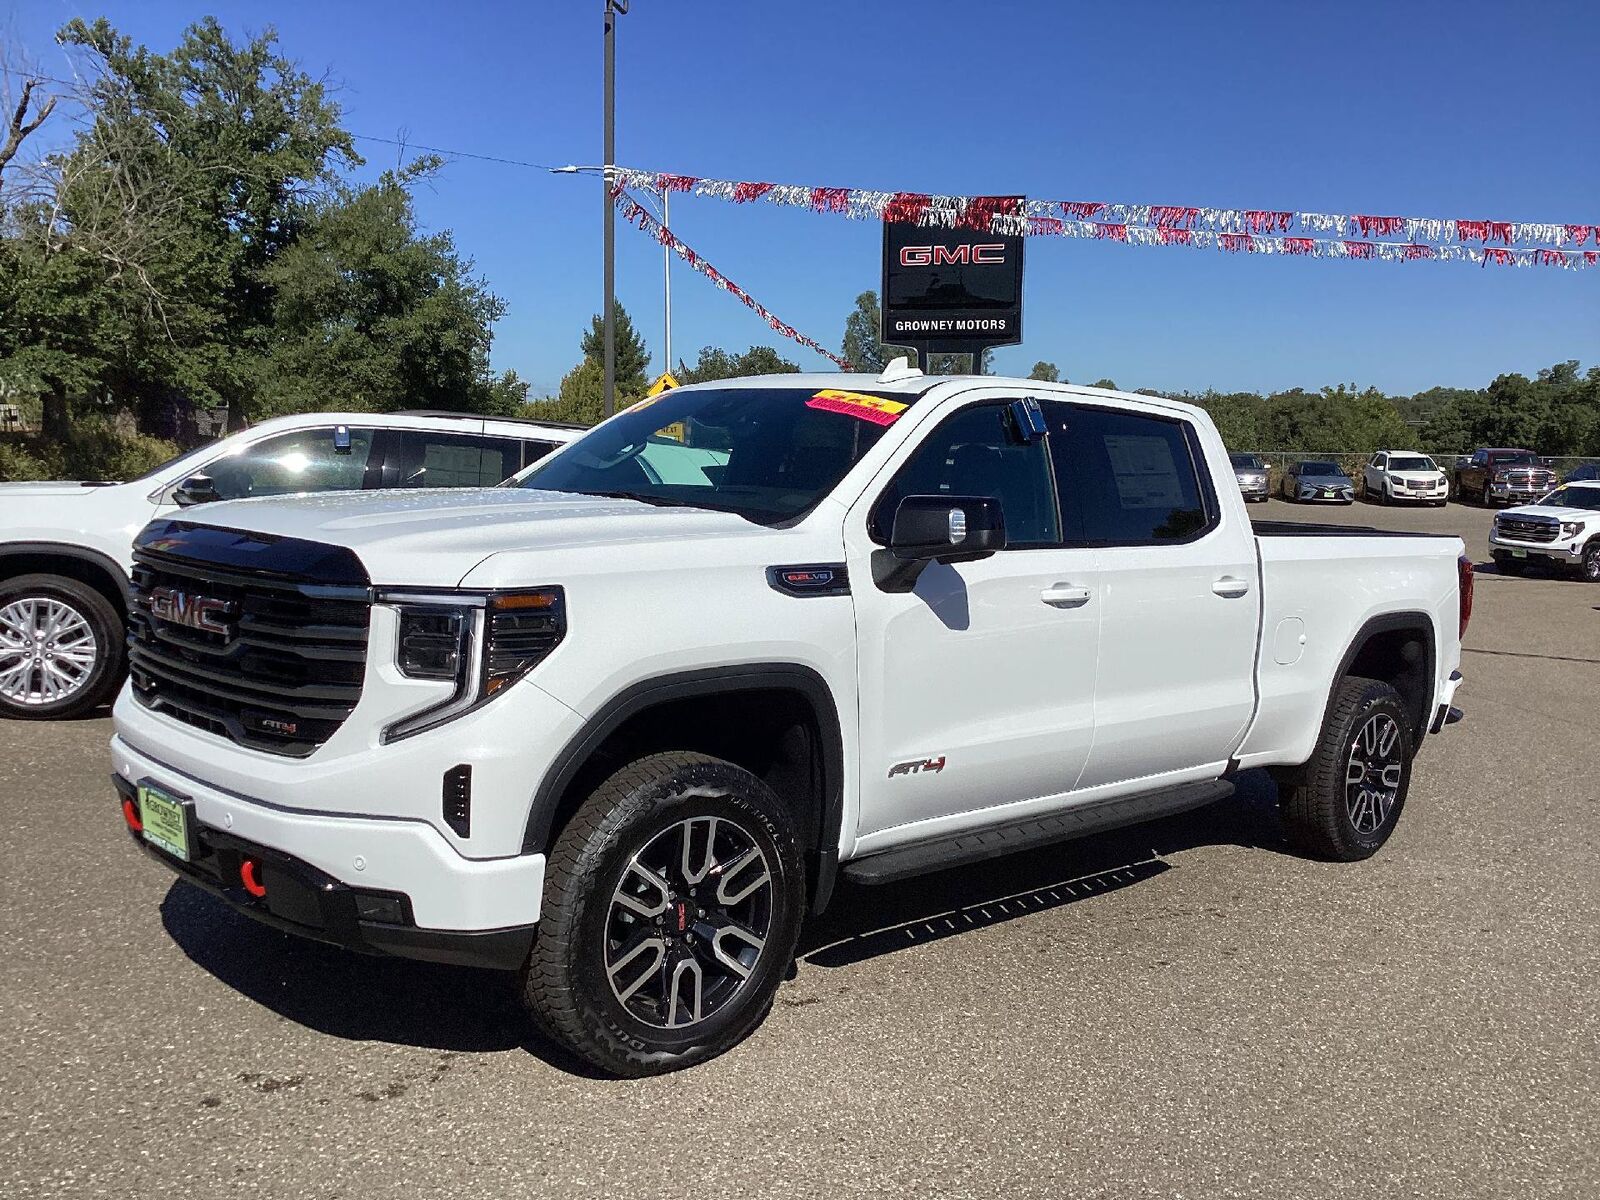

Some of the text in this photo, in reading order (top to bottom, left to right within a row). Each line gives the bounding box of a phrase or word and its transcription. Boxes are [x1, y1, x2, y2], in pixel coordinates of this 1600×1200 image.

[900, 244, 1005, 266] GMC
[896, 319, 1006, 331] GROWNEY MOTORS
[151, 586, 231, 635] GMC
[887, 756, 946, 778] AT4
